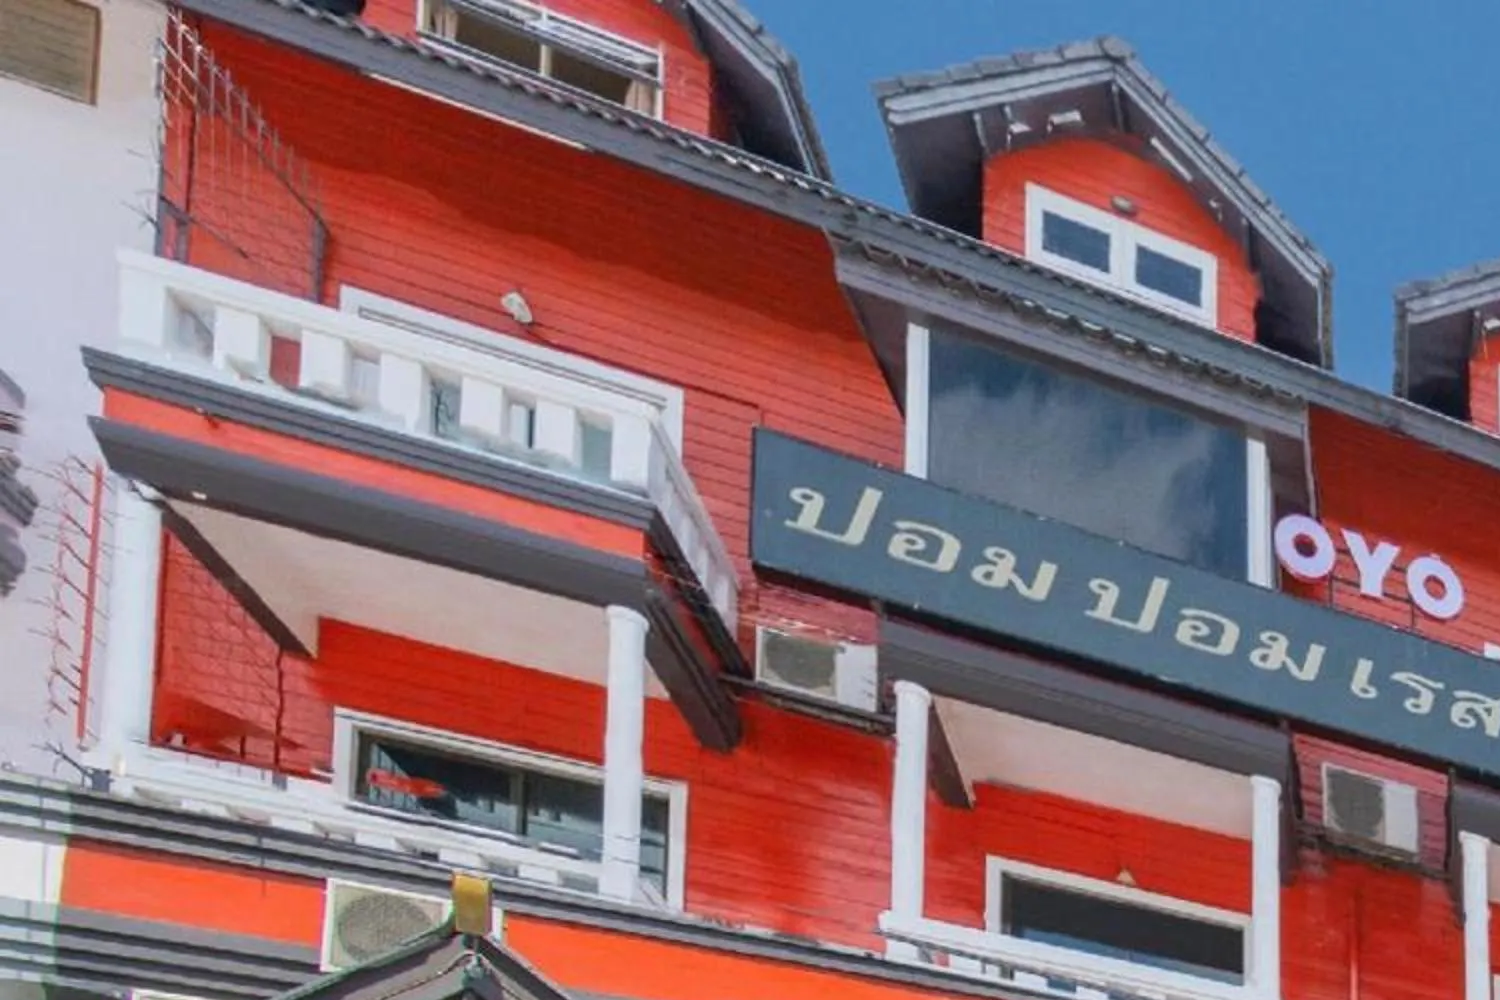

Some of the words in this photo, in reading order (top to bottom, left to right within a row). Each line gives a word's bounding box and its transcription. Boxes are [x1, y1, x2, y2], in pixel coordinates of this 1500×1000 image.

[783, 486, 1058, 601] ปอม
[1084, 577, 1327, 682] ปอม
[1273, 513, 1466, 620] OYO
